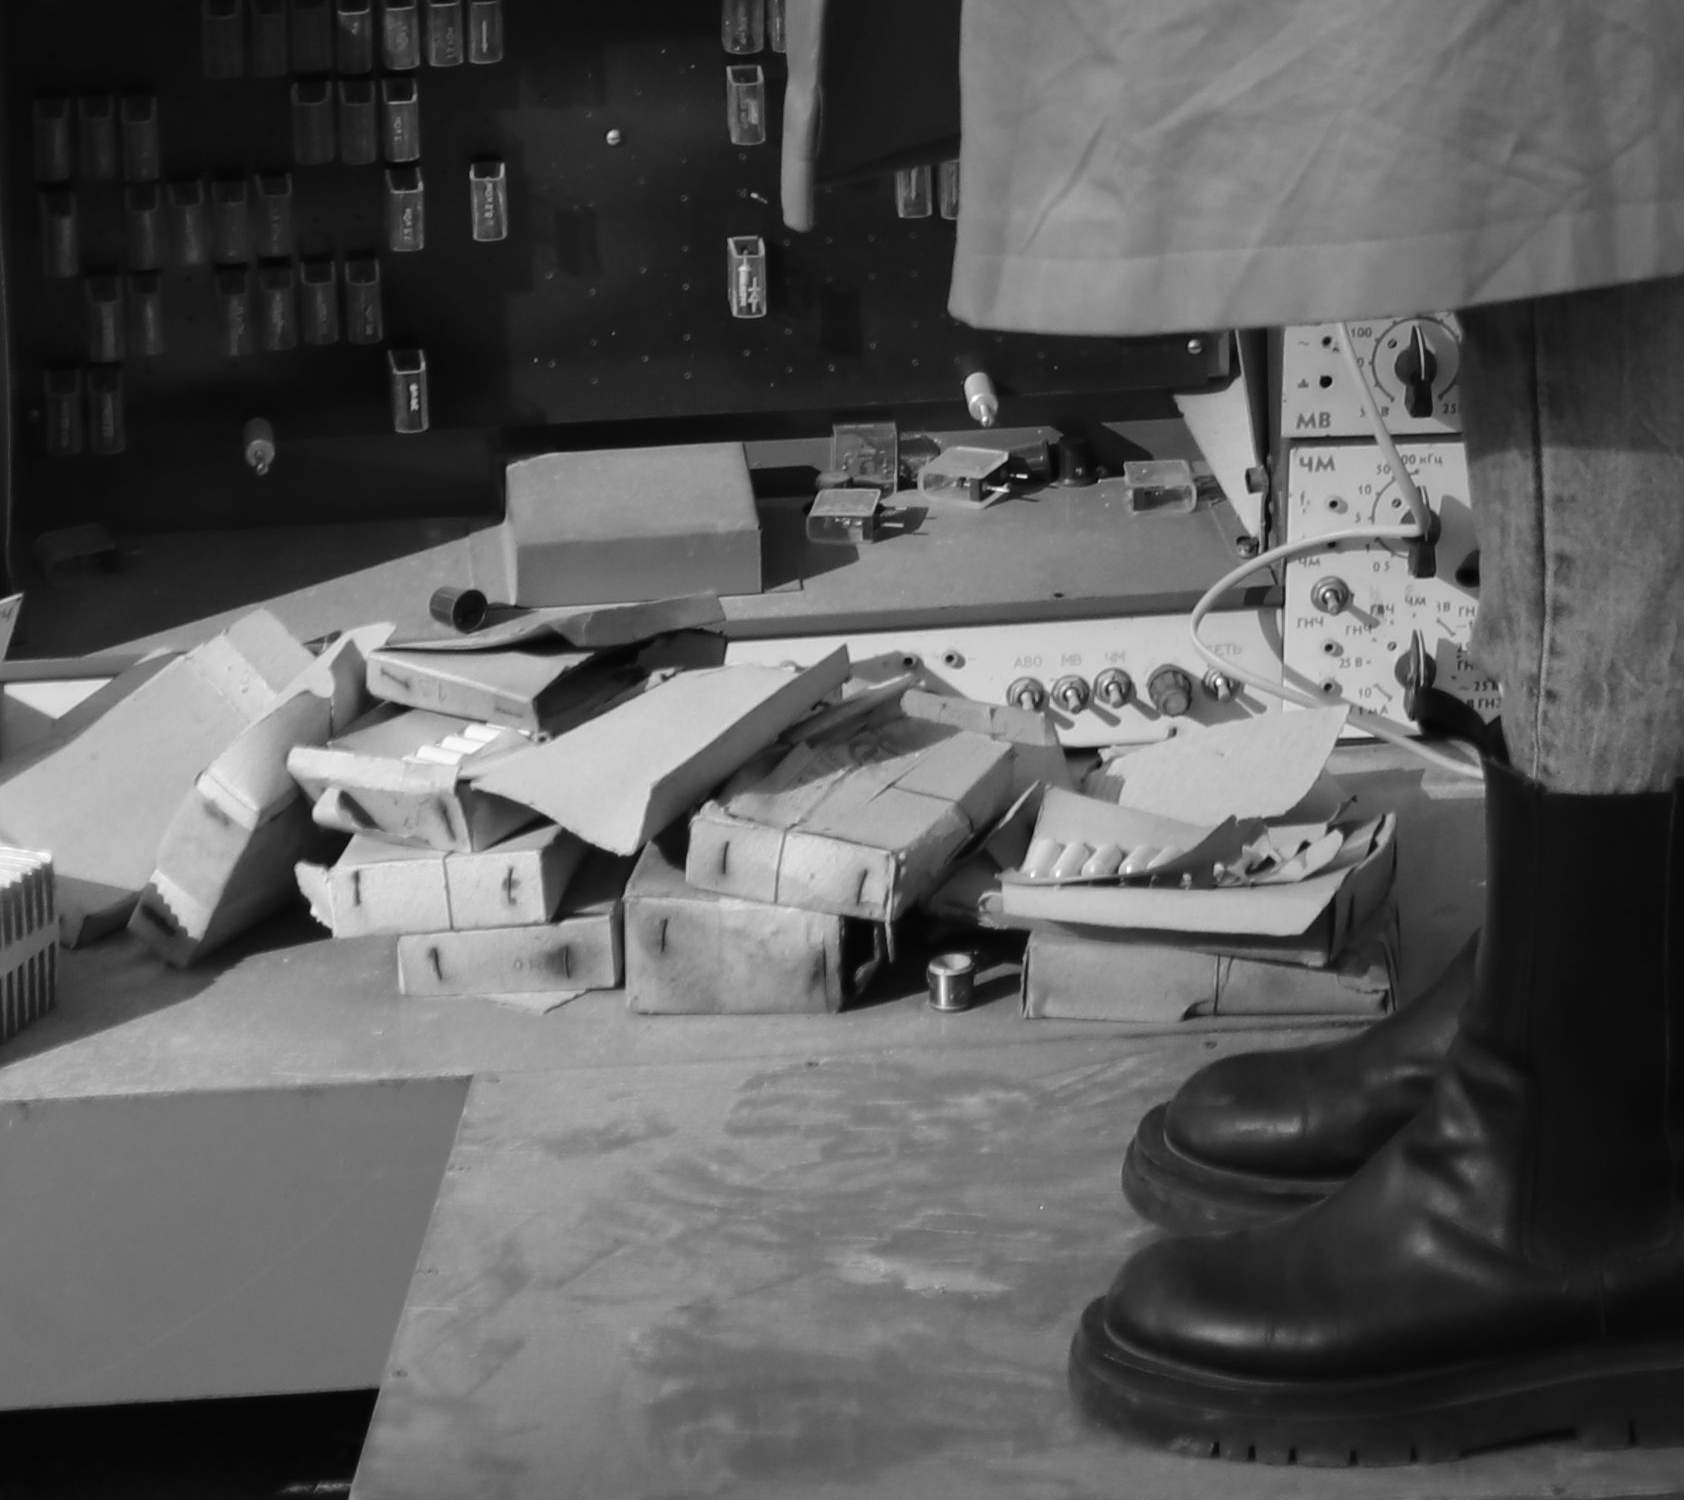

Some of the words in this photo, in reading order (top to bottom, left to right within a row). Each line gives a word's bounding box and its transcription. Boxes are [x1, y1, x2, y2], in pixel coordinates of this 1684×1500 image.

[1350, 327, 1373, 338] 100
[1296, 412, 1331, 429] МВ
[1299, 456, 1336, 472] ЧМ
[1418, 455, 1443, 465] кГц
[1376, 464, 1391, 475] 50
[1358, 484, 1371, 494] 10
[1297, 616, 1324, 629] ГНЧ
[1012, 655, 1044, 670] АВО
[1059, 653, 1082, 668] МВ
[1104, 650, 1126, 665] ЧМ
[1338, 659, 1352, 669] 25
[1358, 688, 1372, 698] 10
